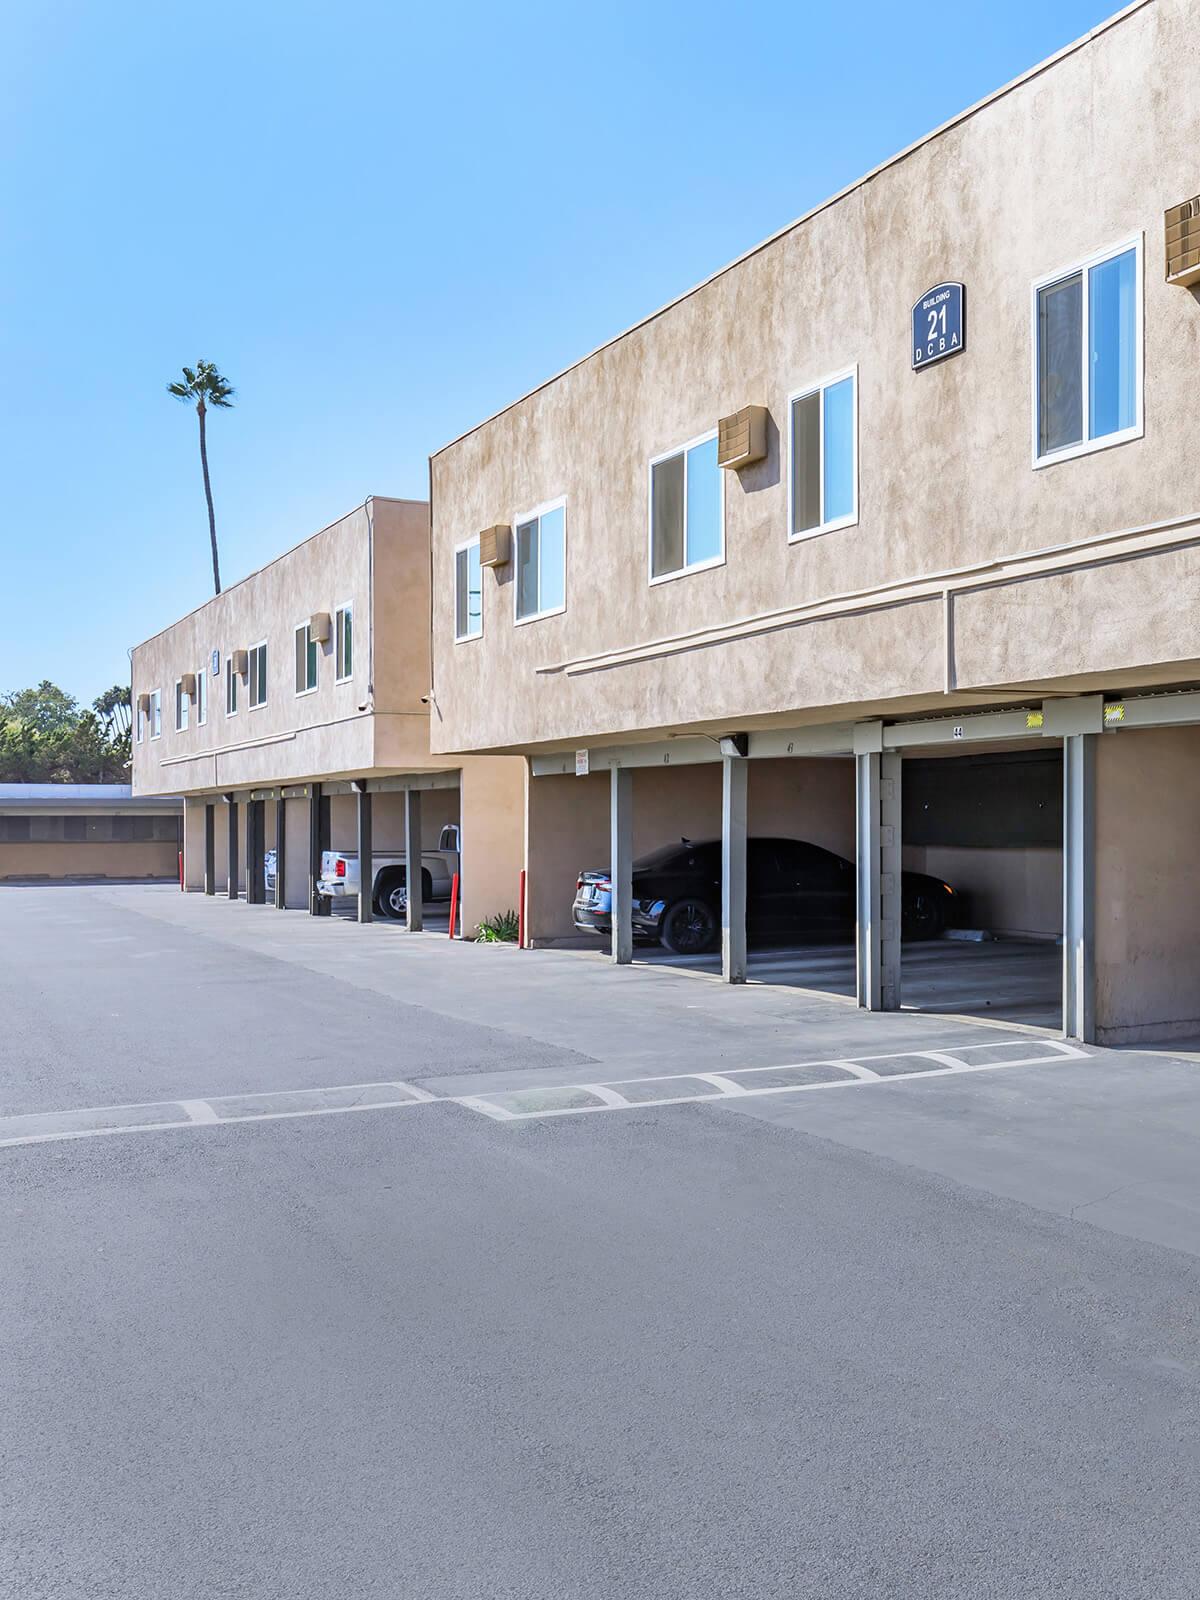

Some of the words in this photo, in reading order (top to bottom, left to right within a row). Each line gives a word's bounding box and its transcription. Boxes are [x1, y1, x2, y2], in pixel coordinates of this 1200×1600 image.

[923, 290, 950, 309] BUILDING
[927, 304, 947, 341] 21
[916, 348, 922, 361] D
[928, 343, 934, 355] C
[939, 338, 946, 351] B
[951, 332, 958, 345] A
